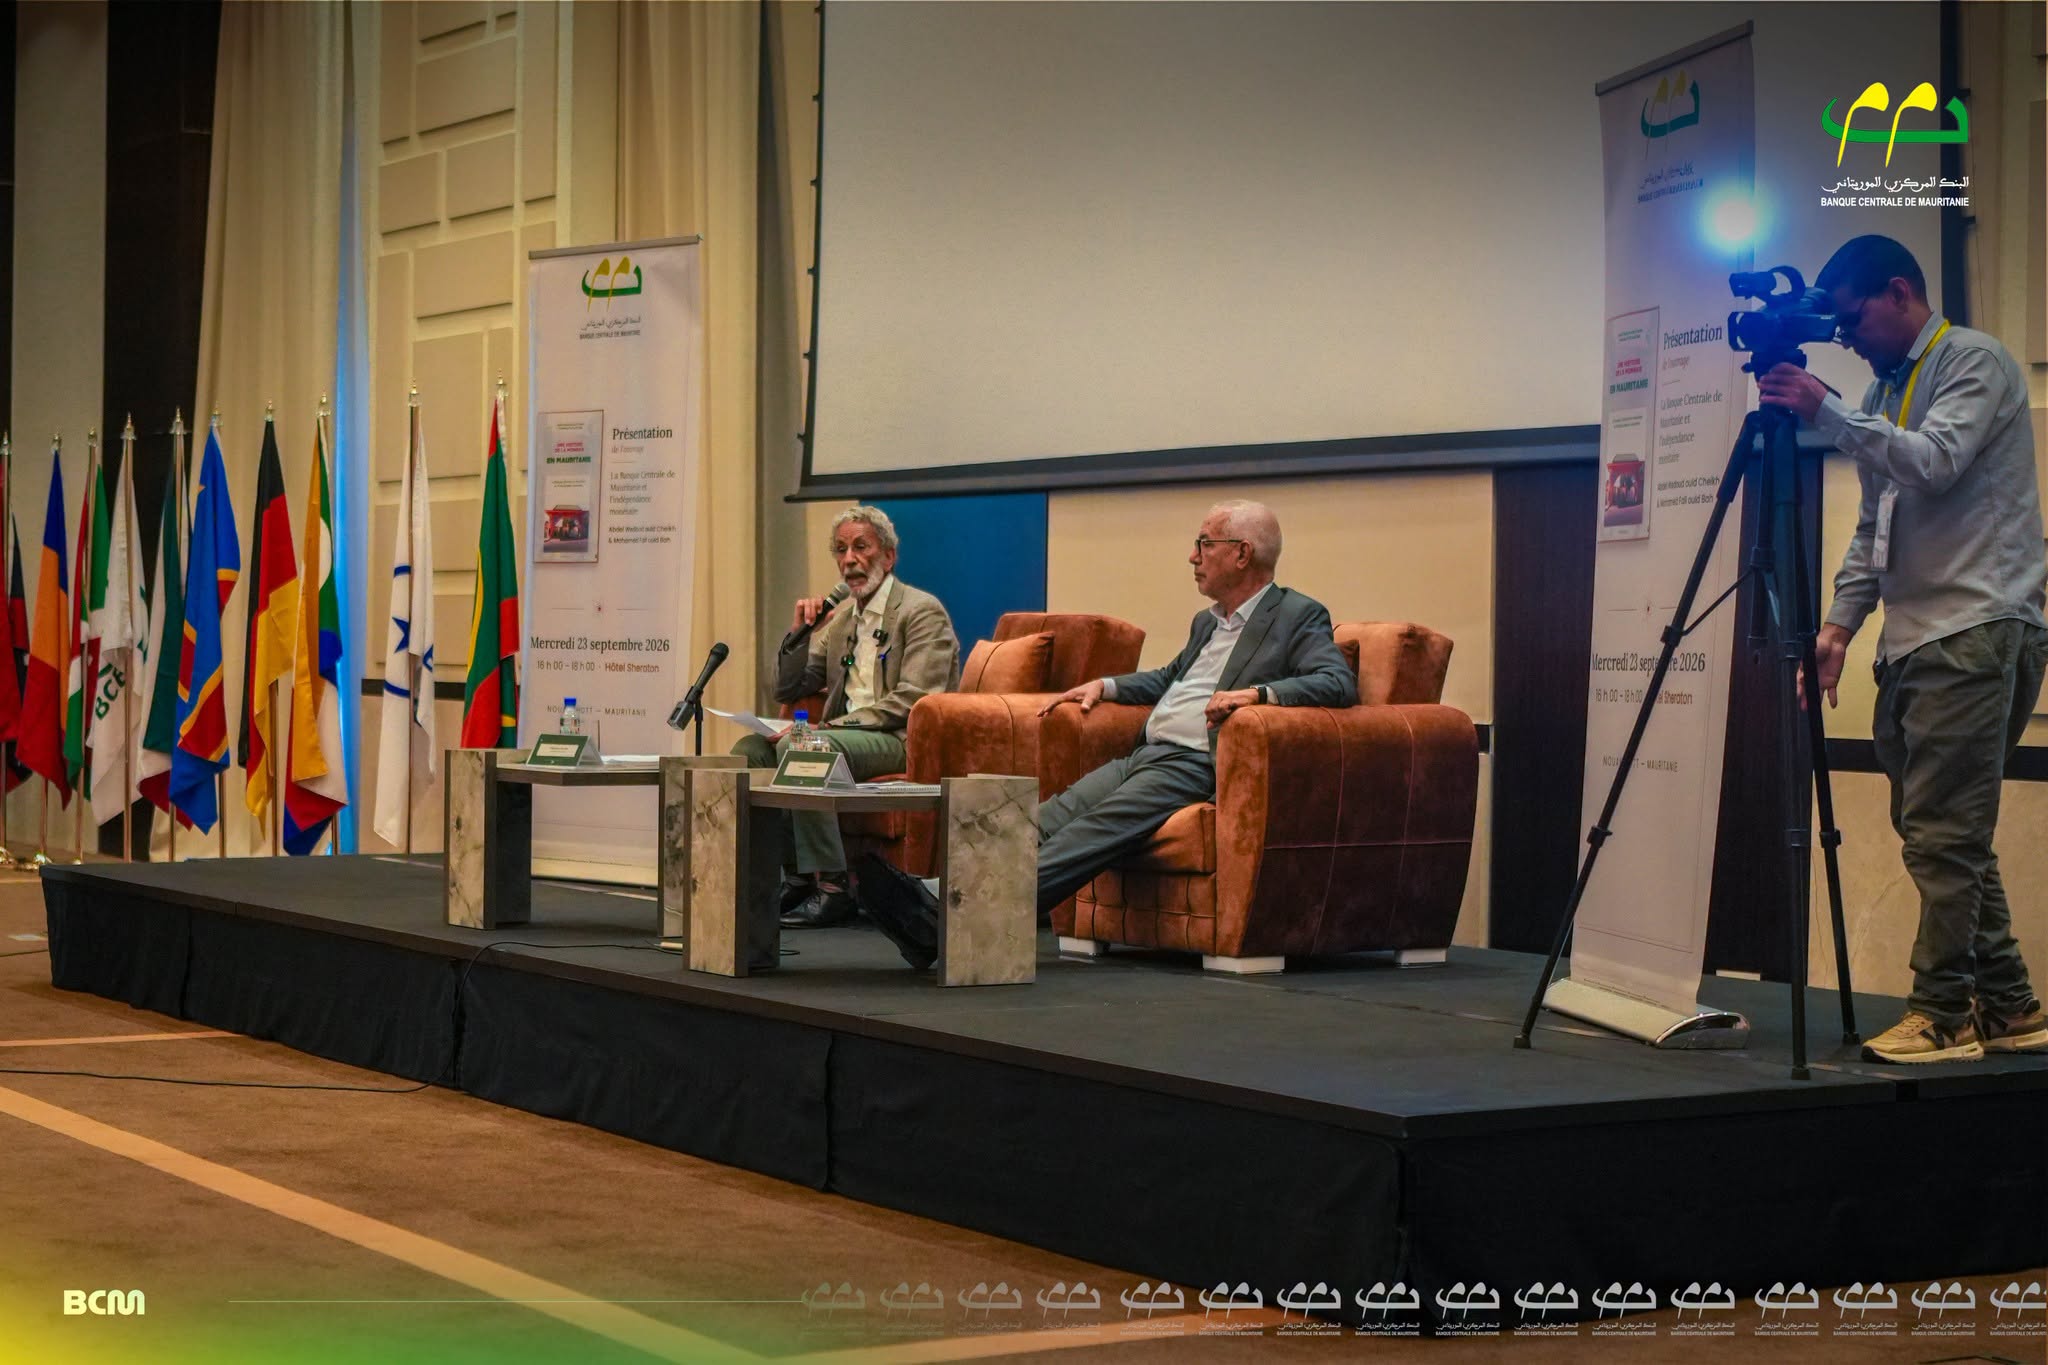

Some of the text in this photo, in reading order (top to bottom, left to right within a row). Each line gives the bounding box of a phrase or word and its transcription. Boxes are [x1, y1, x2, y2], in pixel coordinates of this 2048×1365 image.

[1663, 324, 1723, 350] Présentation
[1684, 392, 1712, 406] Centrale
[1713, 389, 1723, 402] de
[612, 426, 673, 440] Présentation
[530, 636, 670, 654] Mercredi 23 septembre 2026
[537, 661, 545, 670] 16
[546, 660, 552, 670] h
[553, 661, 563, 671] 00
[571, 662, 579, 671] 18
[580, 662, 585, 671] h
[586, 662, 596, 671] 00
[604, 662, 626, 672] Hôtel
[626, 663, 660, 673] Sheraton
[1592, 652, 1628, 671] Mercredi
[1629, 653, 1638, 671] 23
[1679, 652, 1706, 672] 2026
[1603, 689, 1608, 702] h
[1609, 689, 1618, 702] 00
[604, 707, 647, 716] MAURITANIE
